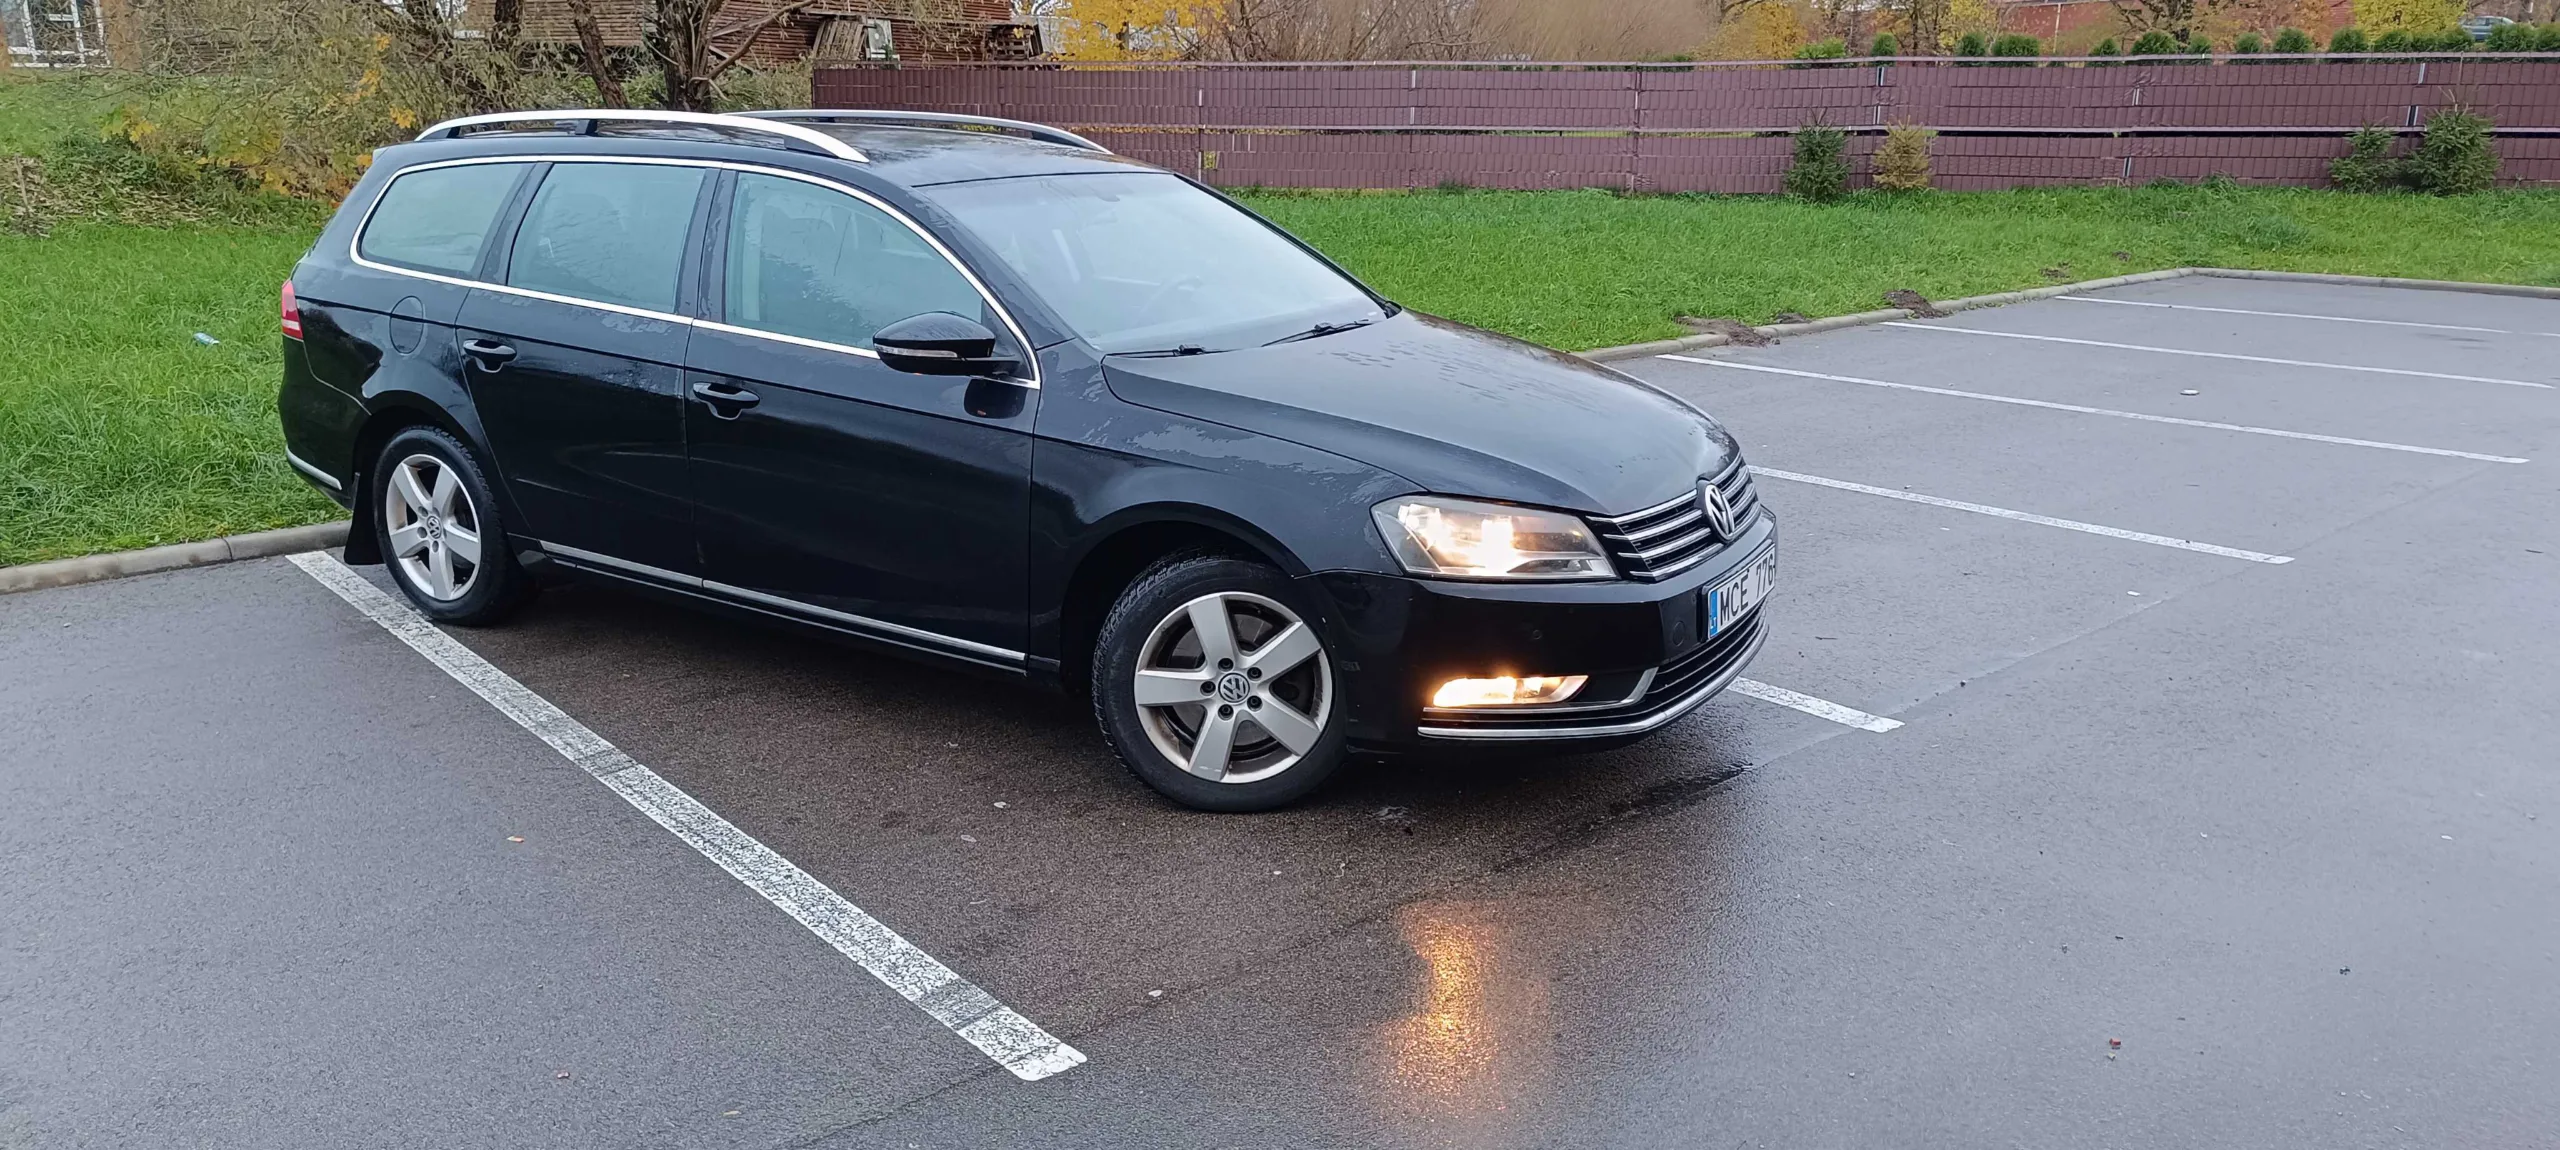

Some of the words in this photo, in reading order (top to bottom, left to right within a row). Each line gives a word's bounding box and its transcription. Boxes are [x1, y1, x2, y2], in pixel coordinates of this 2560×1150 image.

[1720, 574, 1748, 626] MCE
[1756, 556, 1773, 599] 776
[1220, 674, 1249, 702] VW
